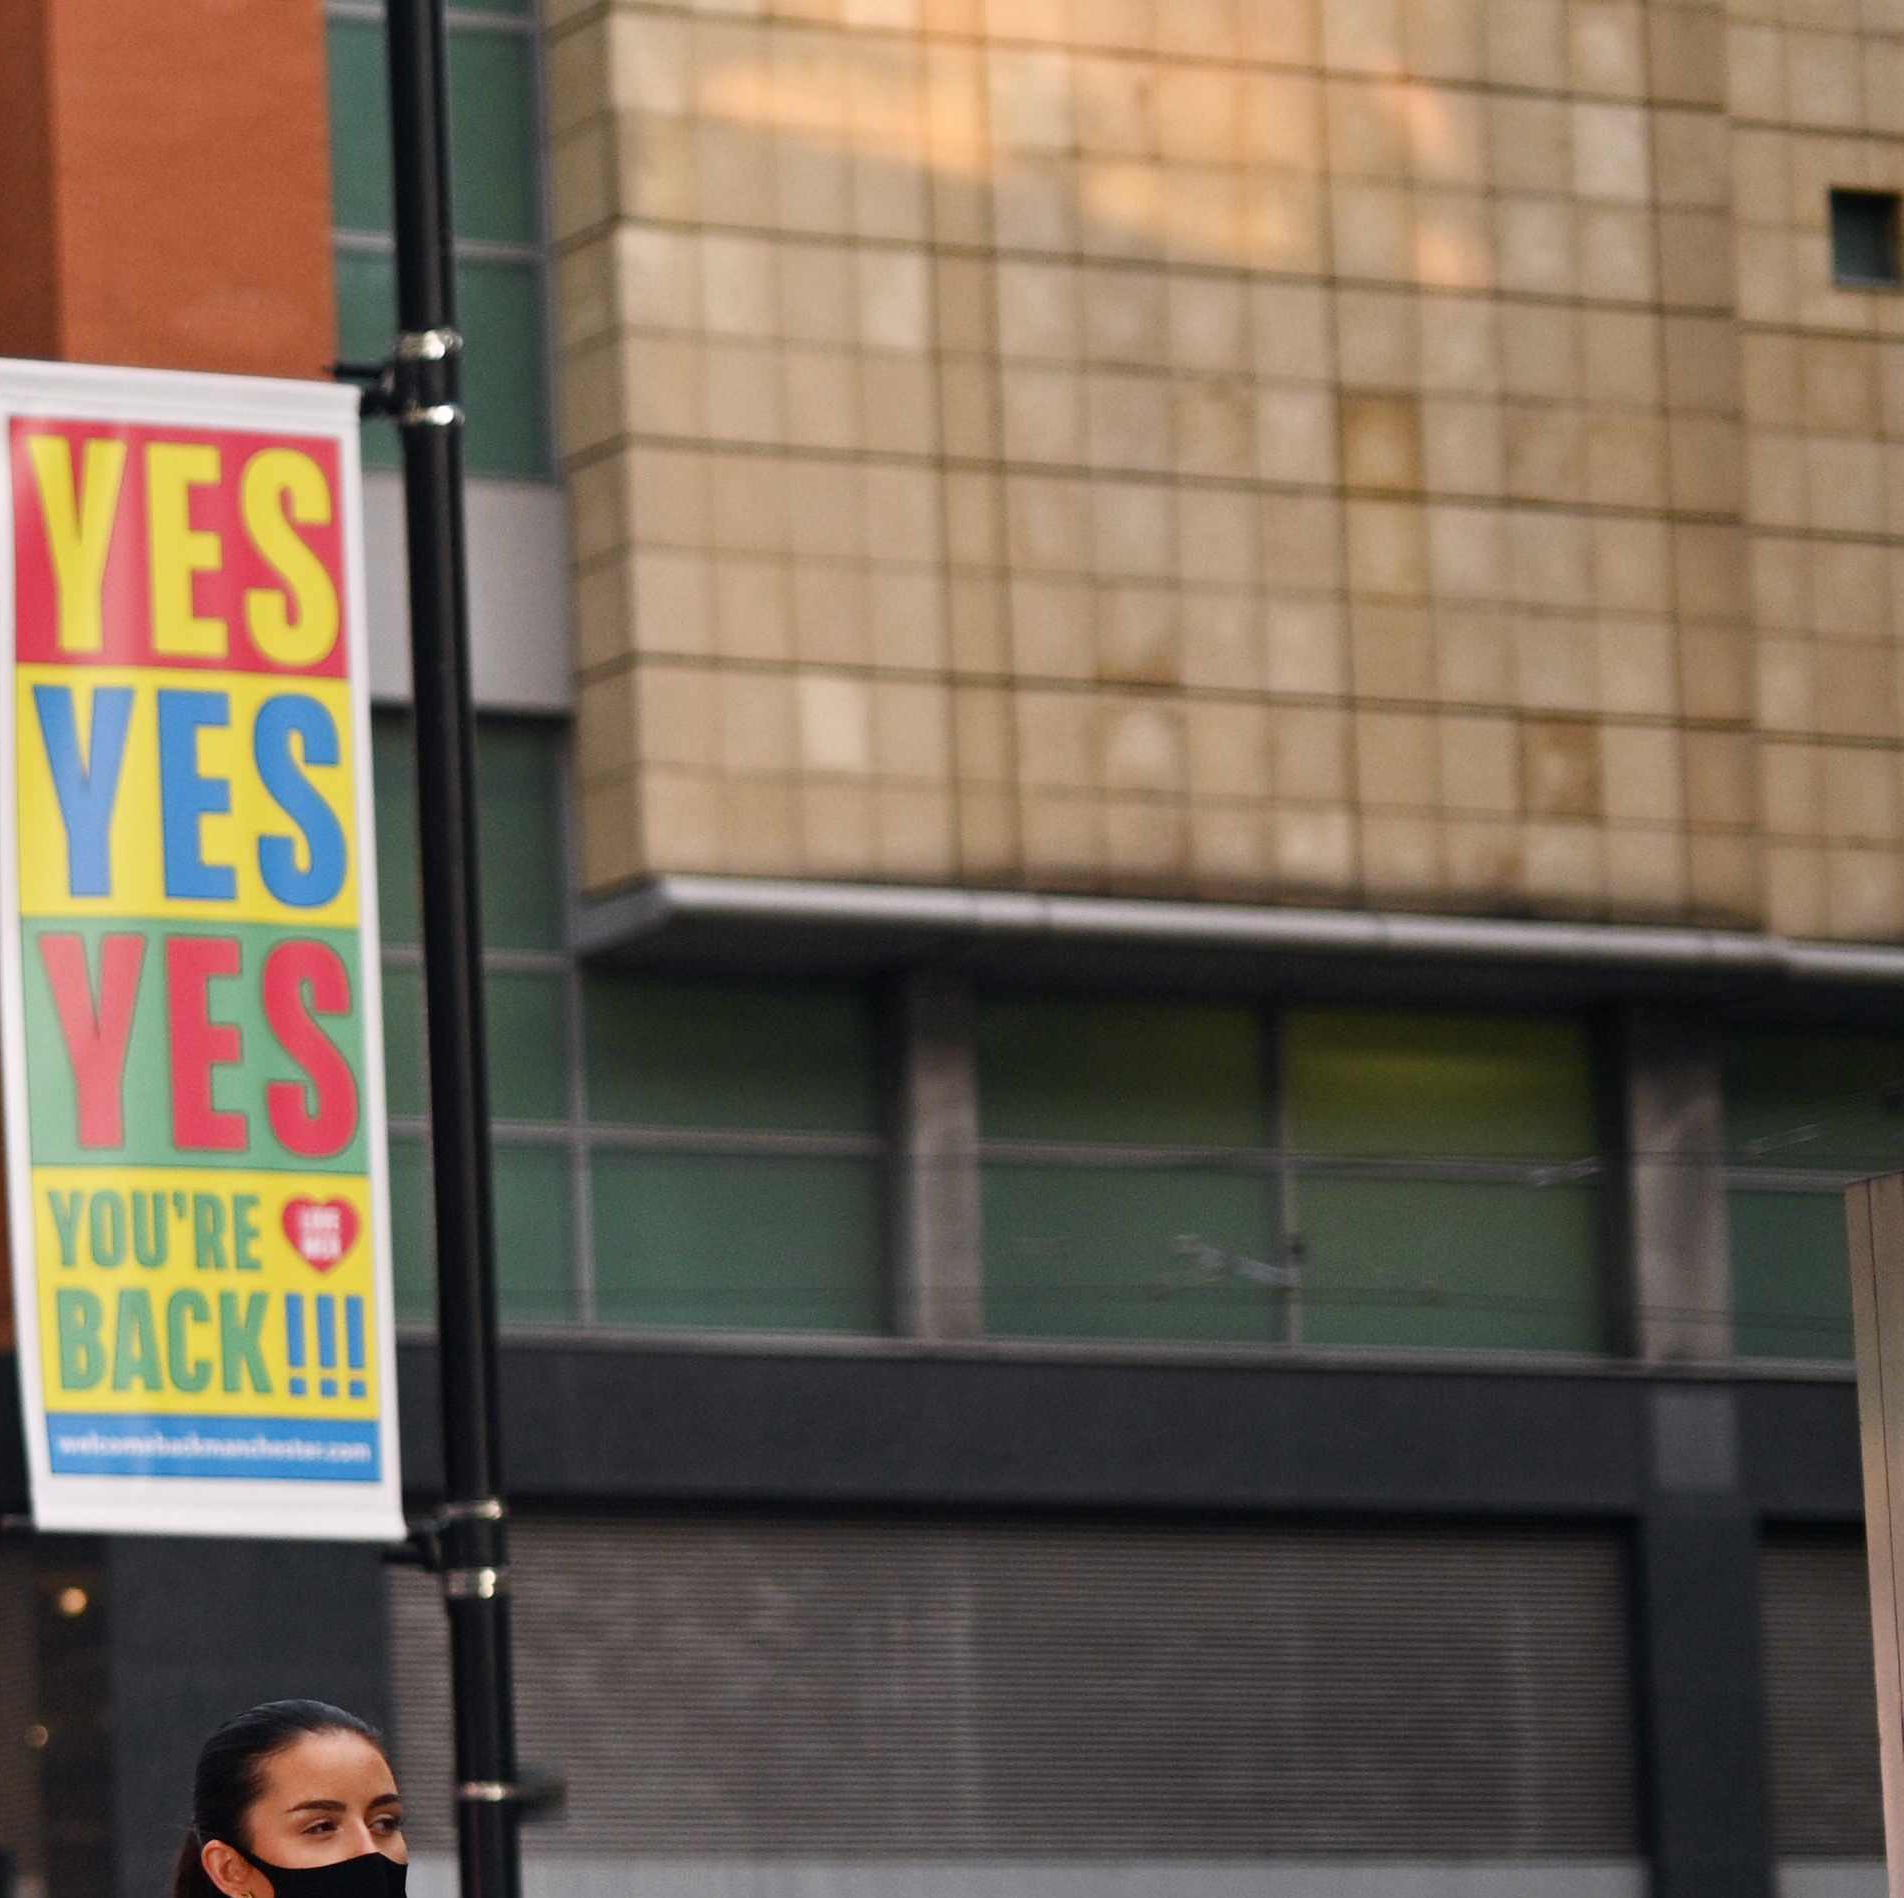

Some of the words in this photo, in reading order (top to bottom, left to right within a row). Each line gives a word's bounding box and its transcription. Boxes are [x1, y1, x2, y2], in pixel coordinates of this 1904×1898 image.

[26, 435, 339, 664] YES
[33, 684, 347, 908] YES
[39, 933, 359, 1158] YES
[48, 1190, 262, 1271] YOU'RE
